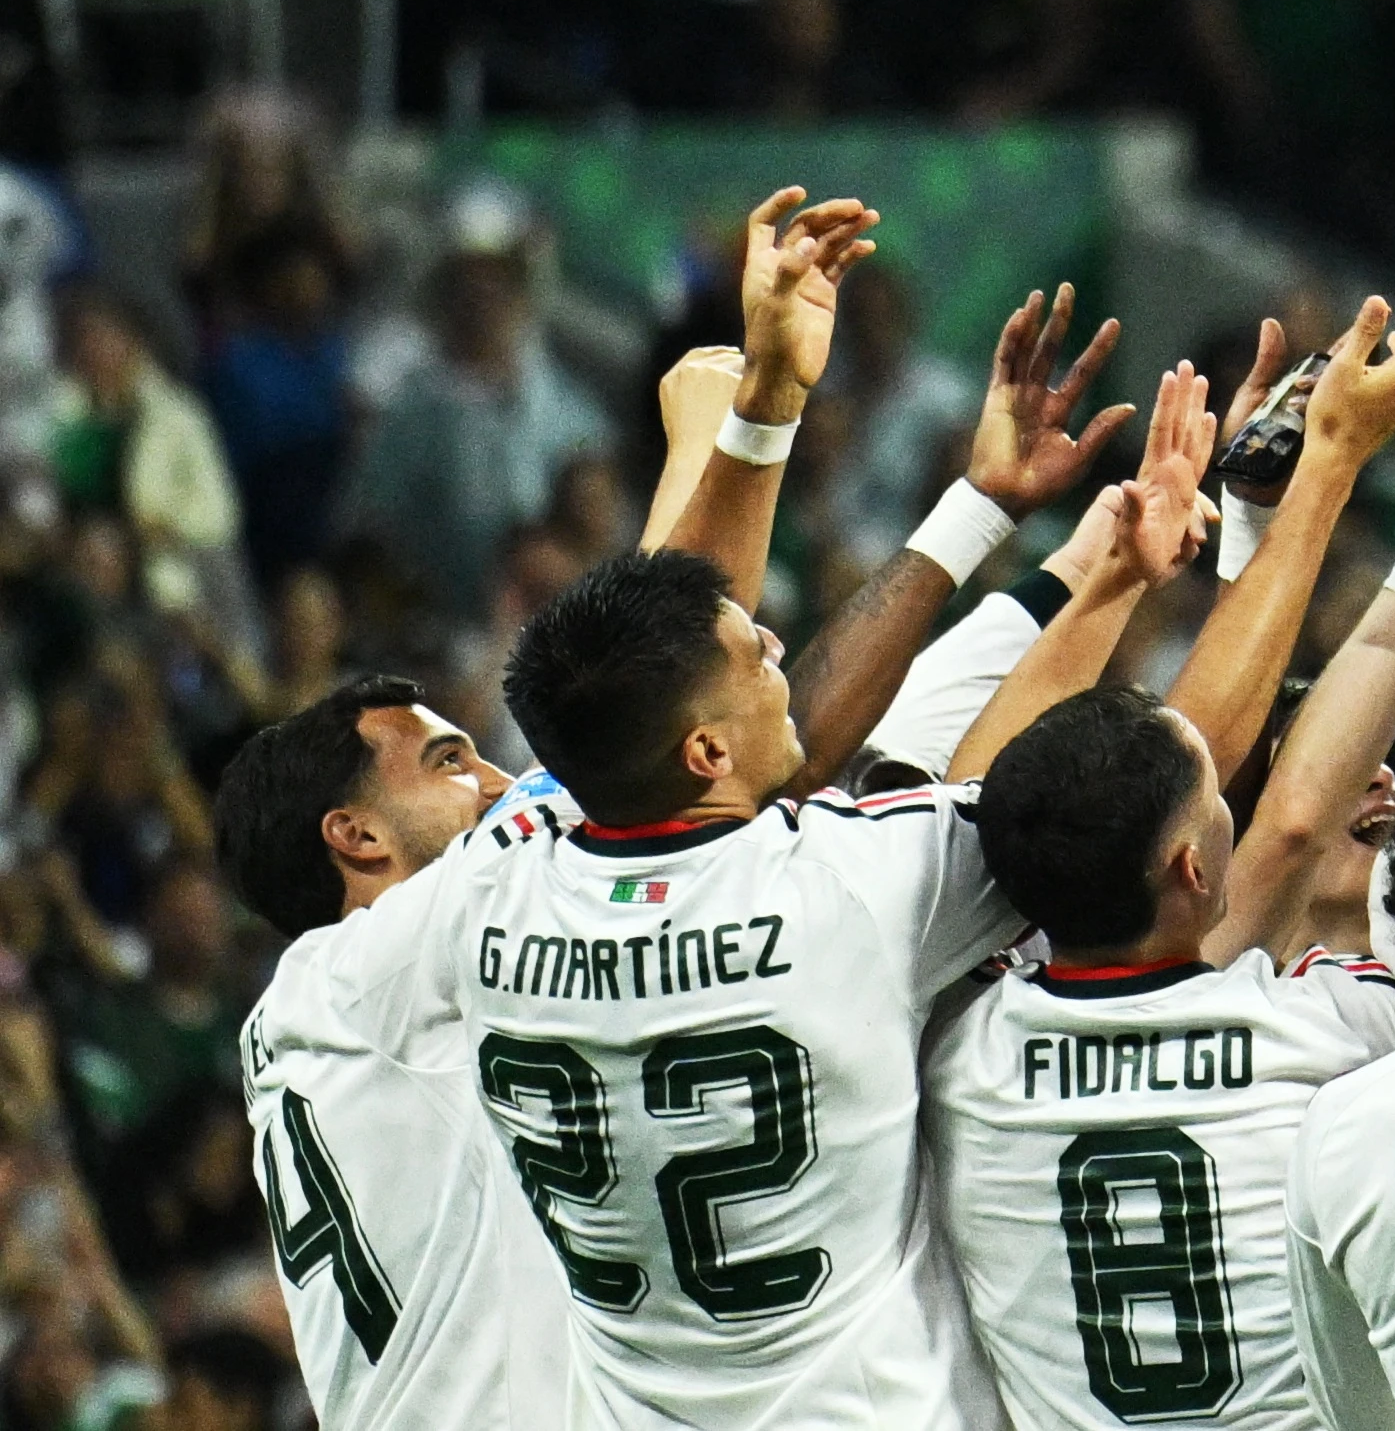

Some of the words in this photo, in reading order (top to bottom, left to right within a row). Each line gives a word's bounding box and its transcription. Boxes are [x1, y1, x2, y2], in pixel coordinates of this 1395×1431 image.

[479, 914, 792, 1001] G.MARTÍNEZ
[1023, 1027, 1253, 1100] FIDALGO
[260, 1086, 403, 1366] 4
[478, 1025, 833, 1323] 22
[1057, 1127, 1244, 1424] 8
